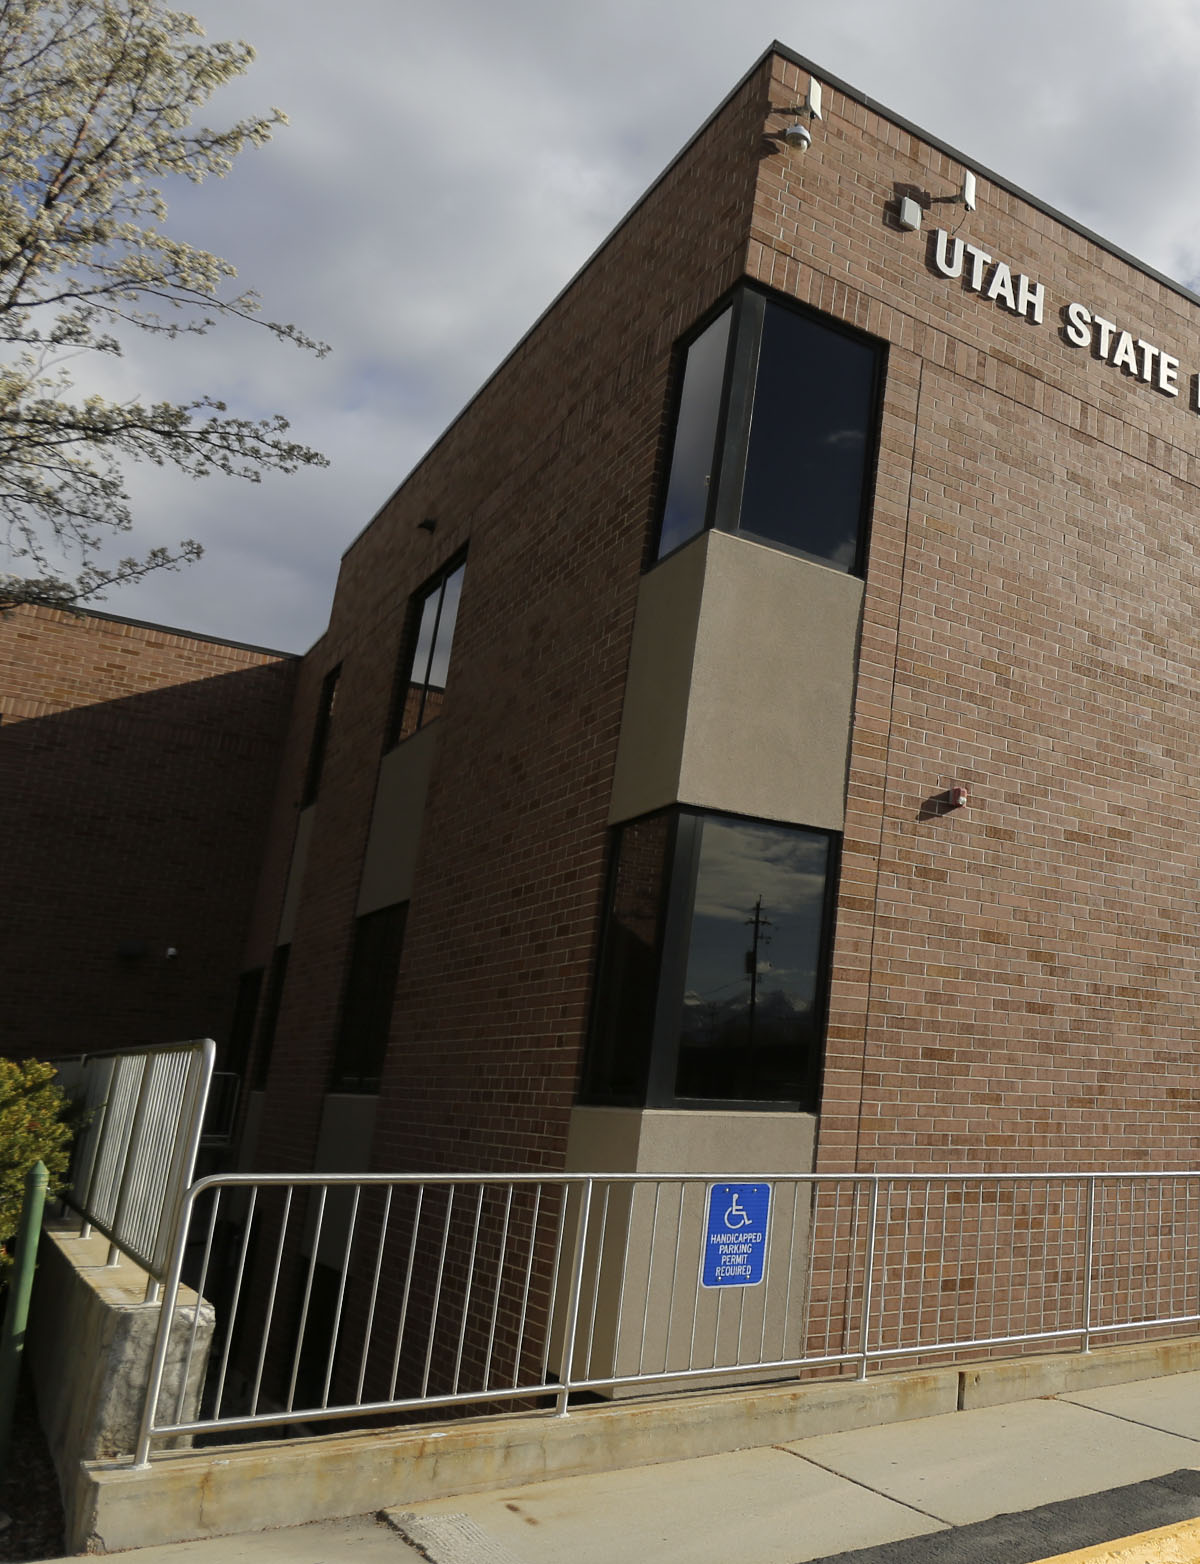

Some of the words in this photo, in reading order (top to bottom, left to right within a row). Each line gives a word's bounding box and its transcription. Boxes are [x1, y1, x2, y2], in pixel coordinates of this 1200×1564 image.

[935, 229, 1045, 324] UTAH
[1065, 302, 1179, 397] STATE
[711, 1233, 762, 1244] HANDICAPPED
[719, 1243, 752, 1254] PARKING
[721, 1254, 748, 1265] PERMIT
[715, 1265, 751, 1276] REQUIRED
